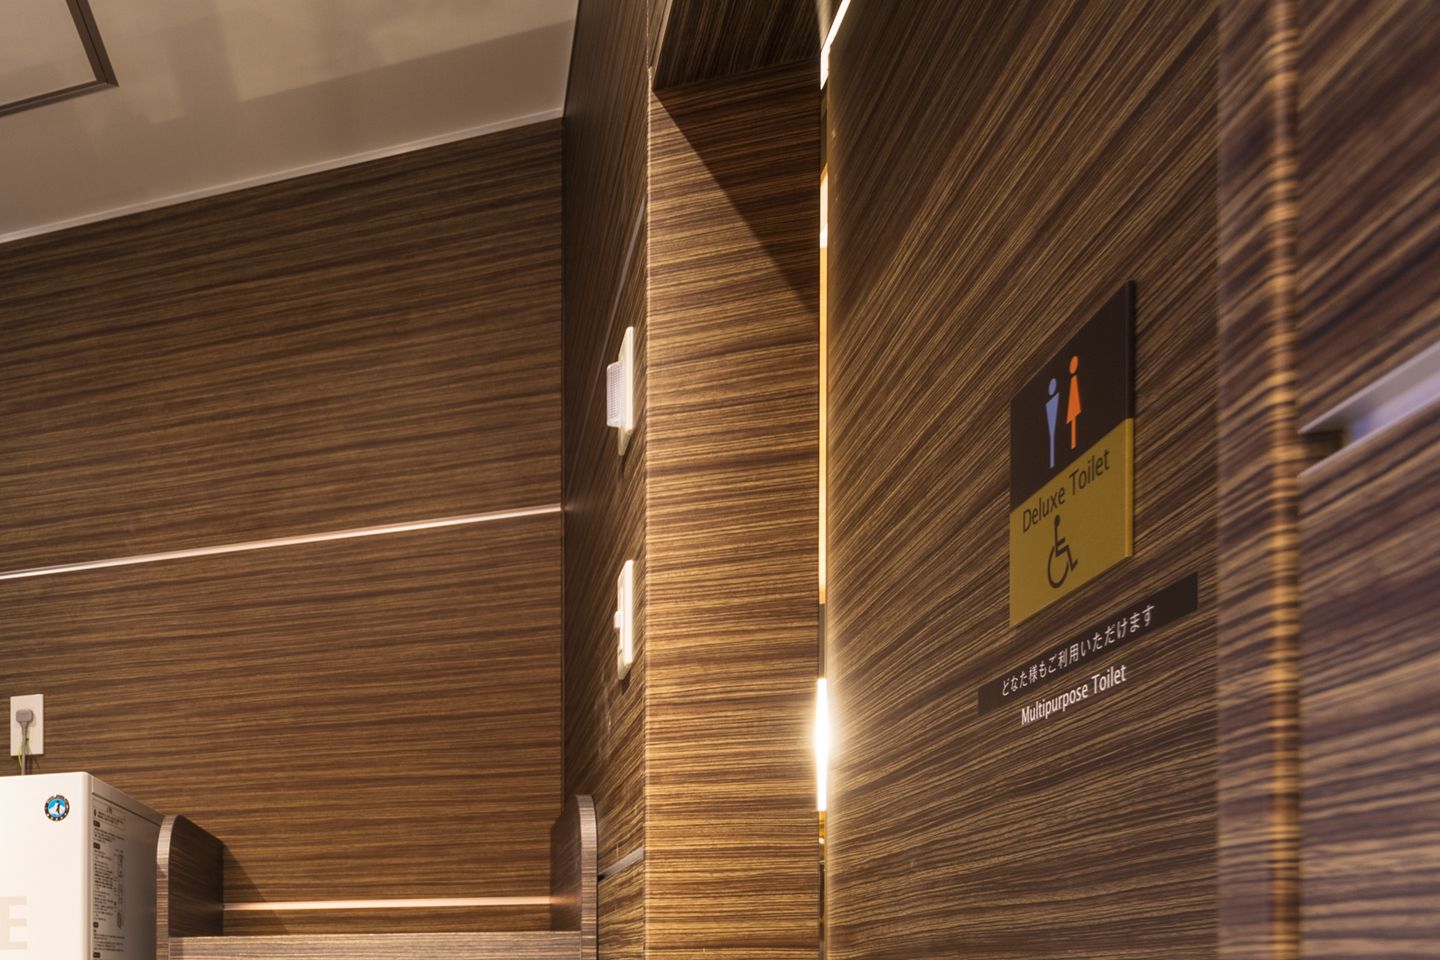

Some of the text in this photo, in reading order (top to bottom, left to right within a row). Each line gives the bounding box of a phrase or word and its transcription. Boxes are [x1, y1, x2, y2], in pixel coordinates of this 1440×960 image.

[1023, 449, 1110, 534] Deluxe Toilet
[1002, 605, 1155, 696] どなた様もご利用いただけます
[1021, 665, 1127, 725] Multipurpose Toilet
